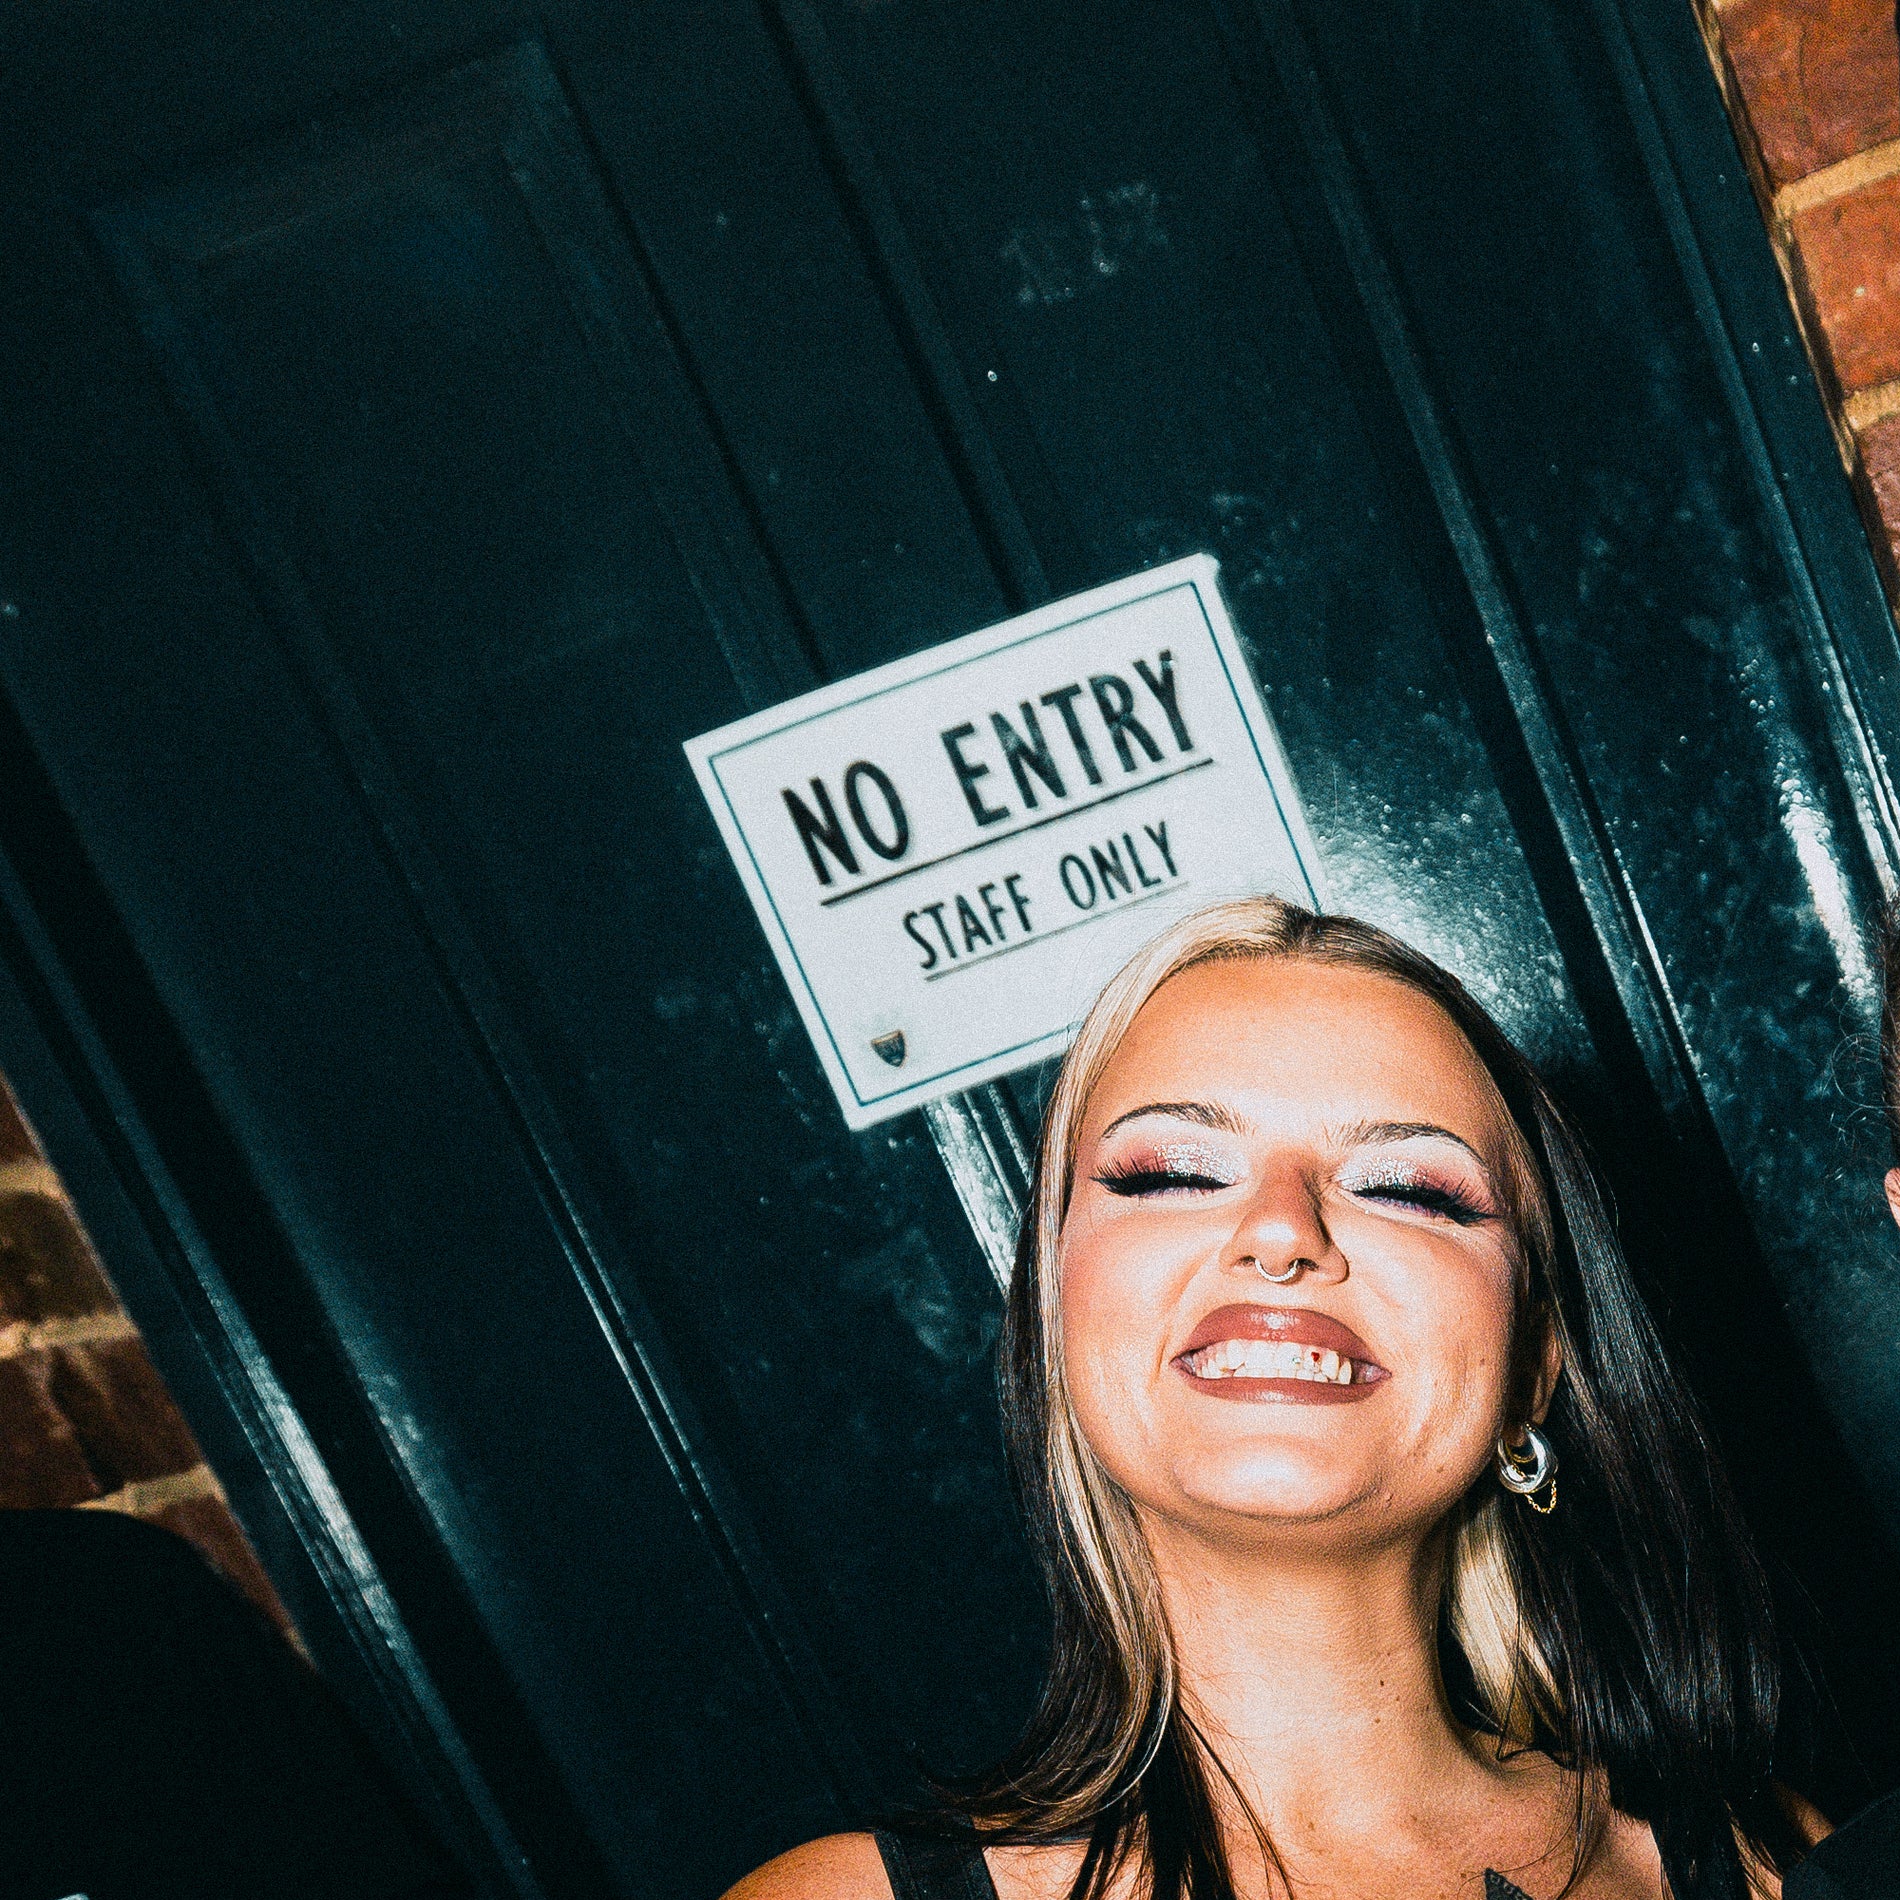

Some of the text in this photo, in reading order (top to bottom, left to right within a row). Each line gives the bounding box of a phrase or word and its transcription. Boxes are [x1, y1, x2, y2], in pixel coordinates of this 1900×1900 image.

[780, 649, 1198, 886] NO ENTRY
[902, 819, 1182, 971] STAFF ONLY
